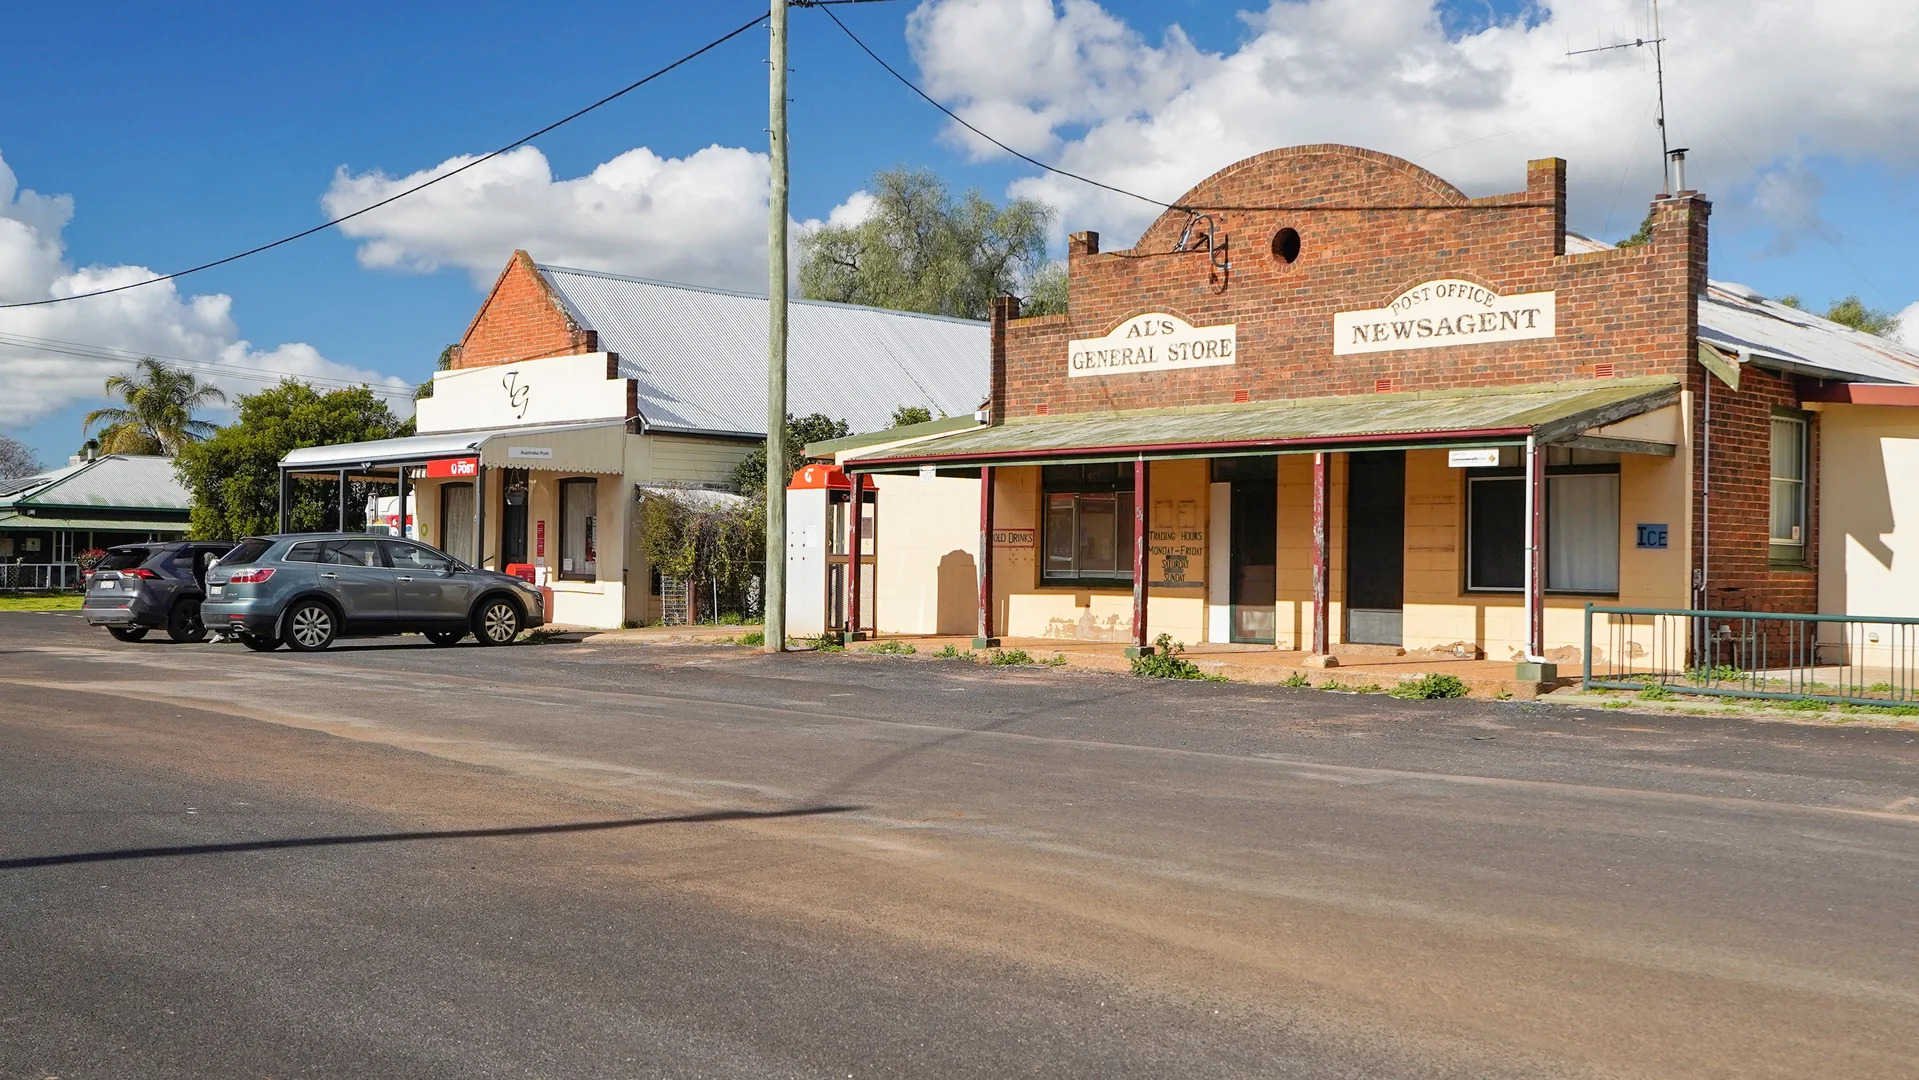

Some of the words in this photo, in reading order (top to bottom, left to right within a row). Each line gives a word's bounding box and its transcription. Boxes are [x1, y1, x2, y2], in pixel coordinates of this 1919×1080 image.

[1391, 286, 1431, 317] POST
[1436, 284, 1496, 308] OFFICE
[1125, 320, 1175, 339] AL'S
[1352, 308, 1541, 344] NEWSAGENT
[1072, 345, 1159, 370] GENERAL
[1167, 338, 1233, 362] STORE
[457, 463, 475, 474] POST
[993, 533, 1007, 543] OLD
[1008, 532, 1033, 544] DRINKS
[1149, 530, 1176, 541] TRADING
[1180, 530, 1203, 541] HOURS
[1637, 526, 1668, 547] ICE
[1161, 559, 1190, 569] SATURDAY
[1163, 572, 1186, 582] SUNDAY
